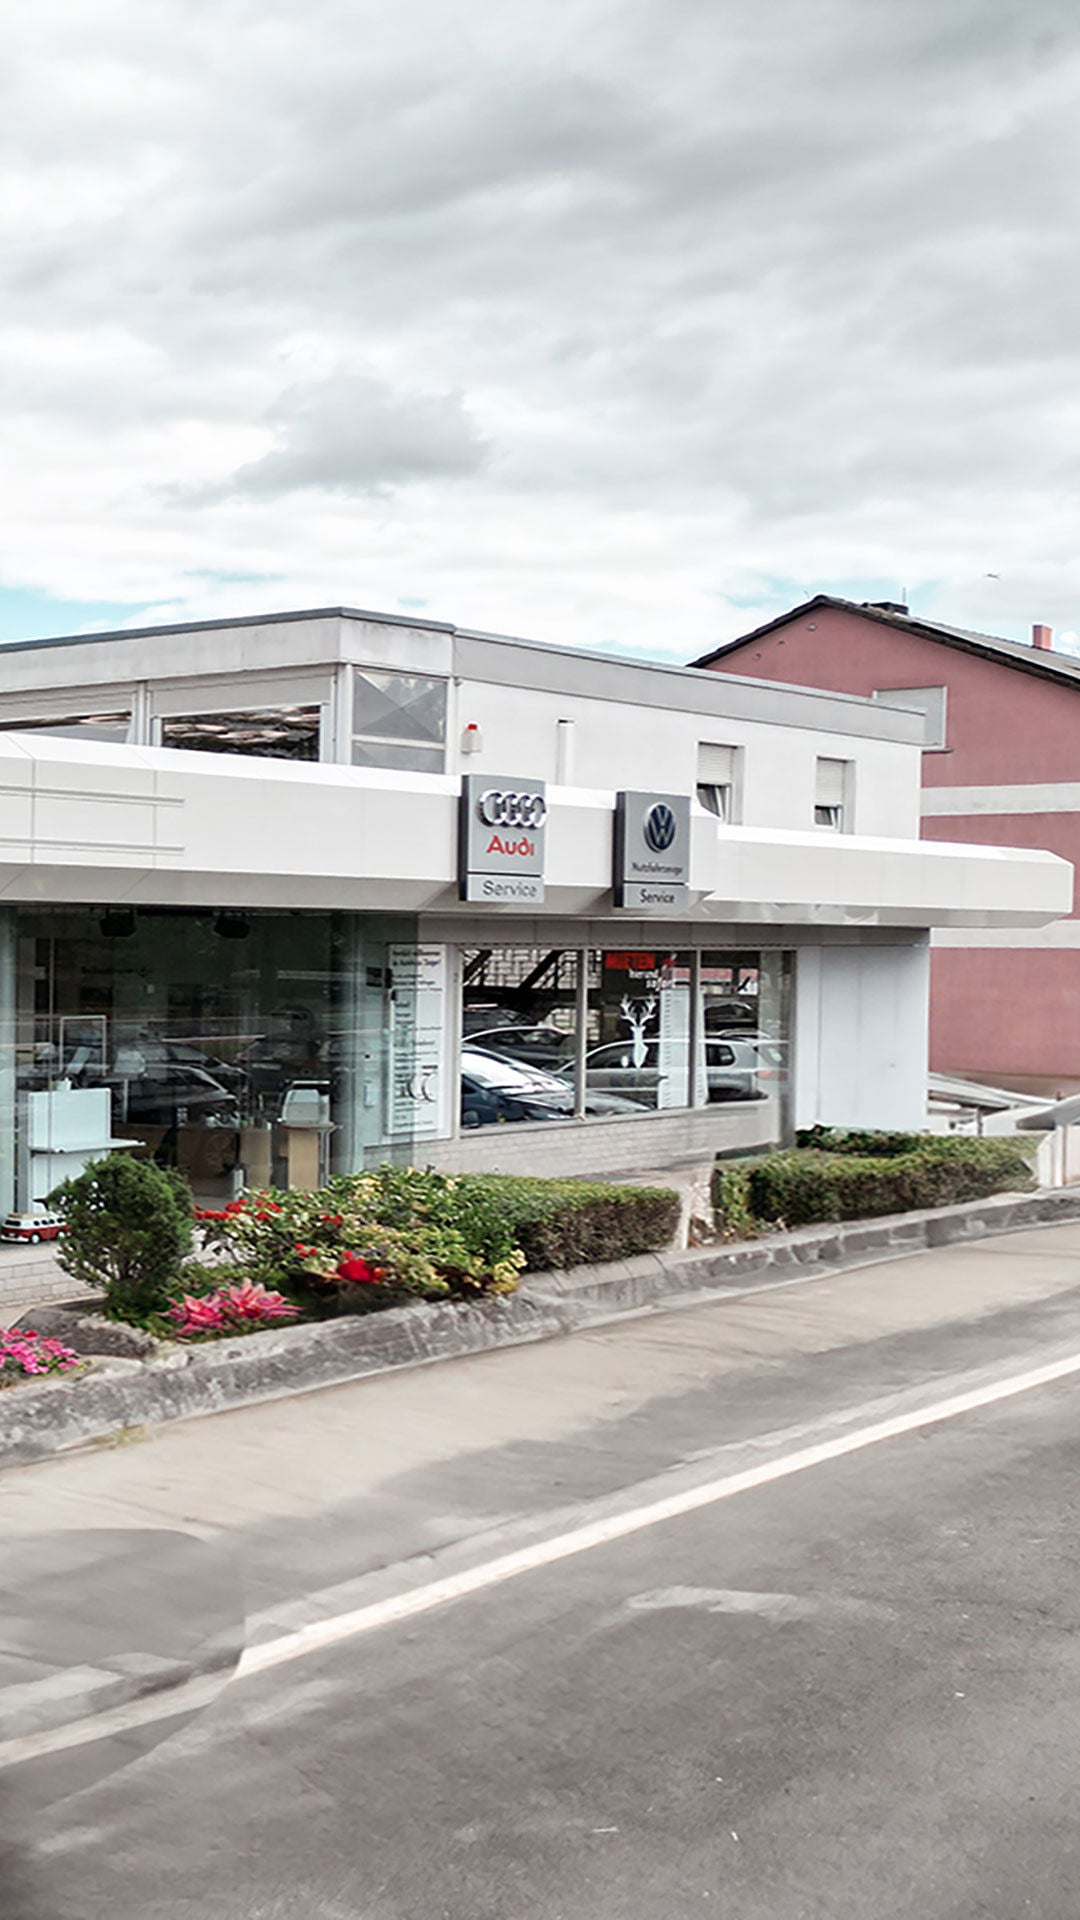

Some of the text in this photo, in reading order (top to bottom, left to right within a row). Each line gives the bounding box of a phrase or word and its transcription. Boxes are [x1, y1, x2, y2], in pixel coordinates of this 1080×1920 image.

[486, 835, 535, 857] Audi
[482, 879, 538, 897] Service
[640, 888, 675, 904] Service
